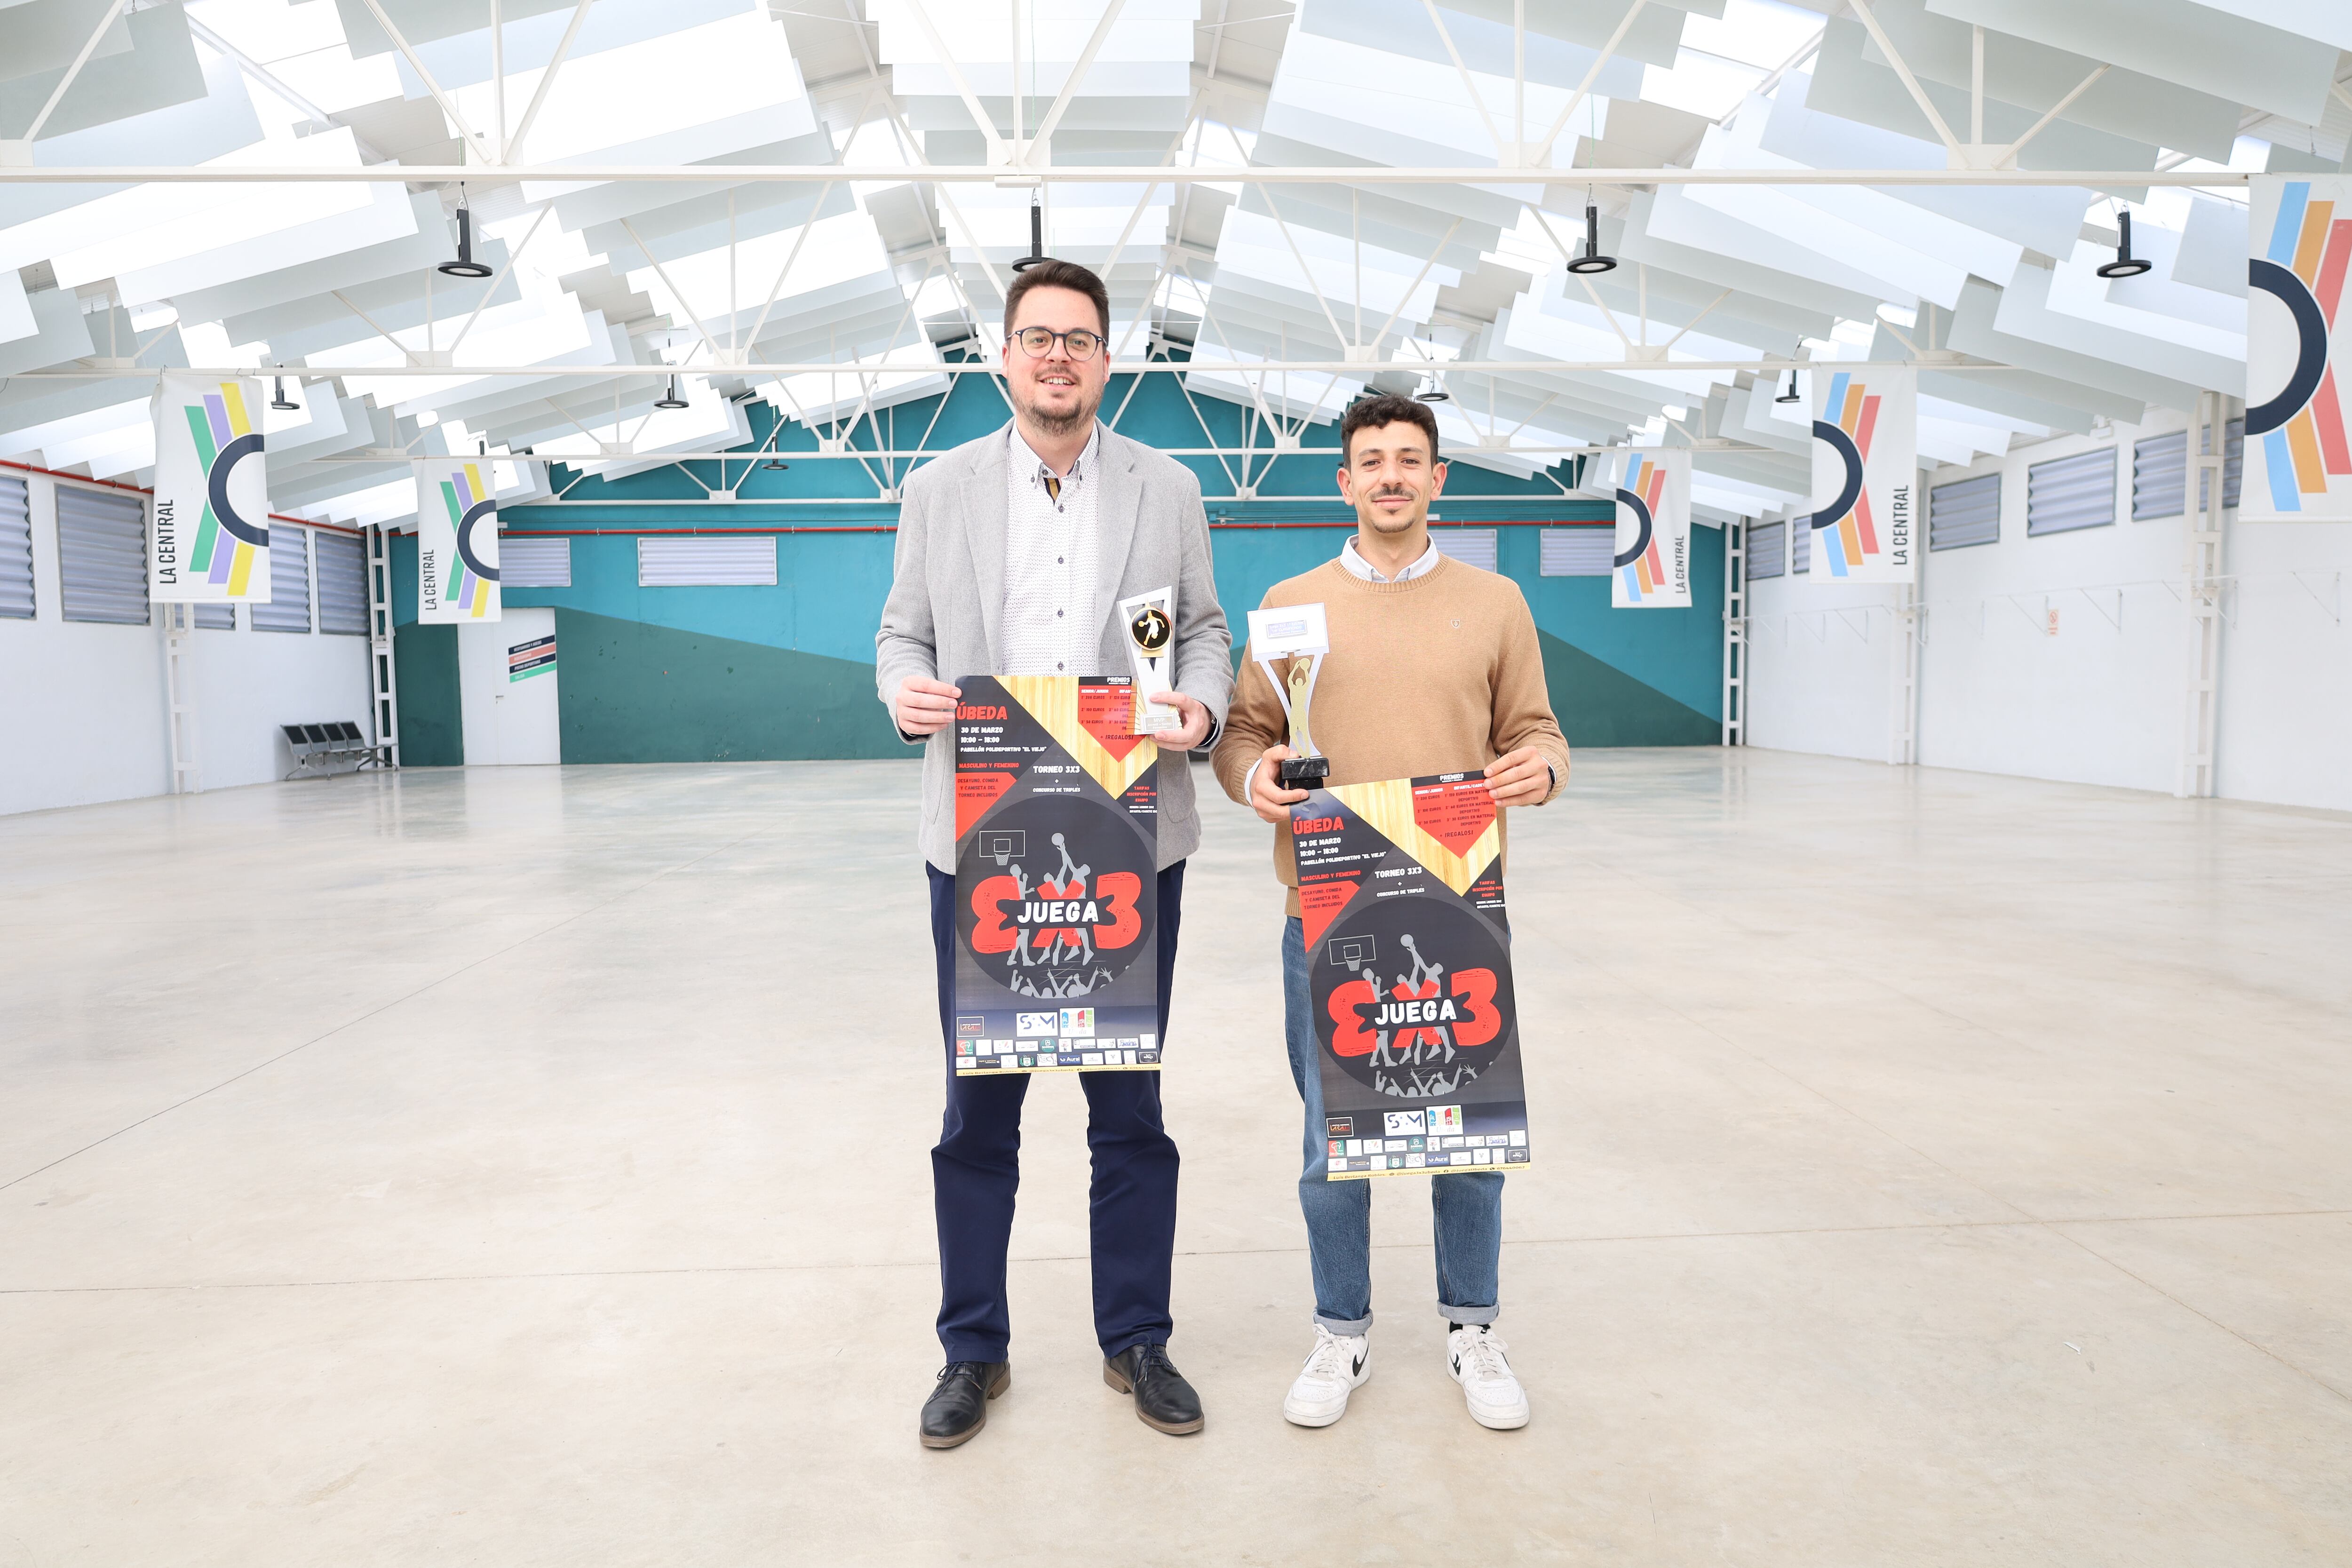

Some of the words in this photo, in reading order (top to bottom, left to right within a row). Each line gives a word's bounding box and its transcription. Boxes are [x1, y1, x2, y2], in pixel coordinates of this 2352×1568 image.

[1893, 485, 1908, 545] CENTRAL
[158, 500, 175, 563] CENTRAL
[1675, 535, 1684, 579] CENTRAL
[1893, 550, 1907, 565] LA
[159, 567, 176, 583] LA
[422, 549, 436, 595] CENTRAL
[1676, 582, 1686, 593] LA
[425, 598, 437, 610] LA
[957, 702, 1008, 720] ÚBEDA
[1294, 816, 1344, 835] ÚBEDA
[1326, 855, 1361, 863] POLIDEPORTIVO
[1375, 868, 1405, 879] TORNEO
[1407, 867, 1422, 875] 3X3
[1017, 901, 1099, 923] JUEGA
[1375, 999, 1456, 1025] JUEGA
